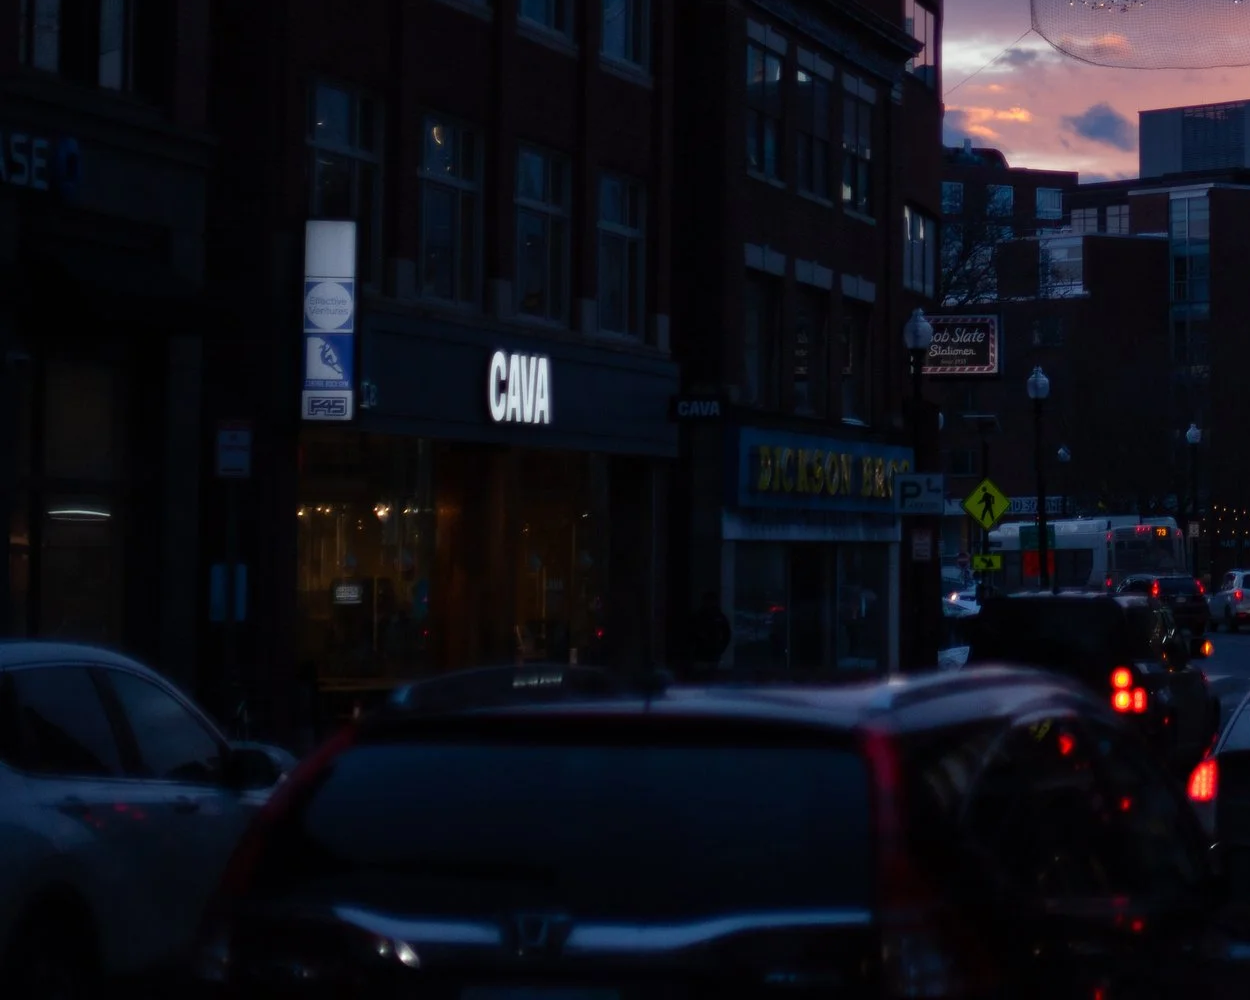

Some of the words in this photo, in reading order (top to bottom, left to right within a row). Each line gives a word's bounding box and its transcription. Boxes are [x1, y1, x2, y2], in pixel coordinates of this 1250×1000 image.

[308, 306, 349, 315] Ventures
[930, 327, 950, 343] ob
[951, 327, 986, 343] Slate
[489, 350, 550, 425] CAVA
[308, 397, 347, 416] F45
[677, 400, 721, 417] CAVA
[757, 446, 852, 496] DICKSON
[1156, 528, 1168, 537] 73
